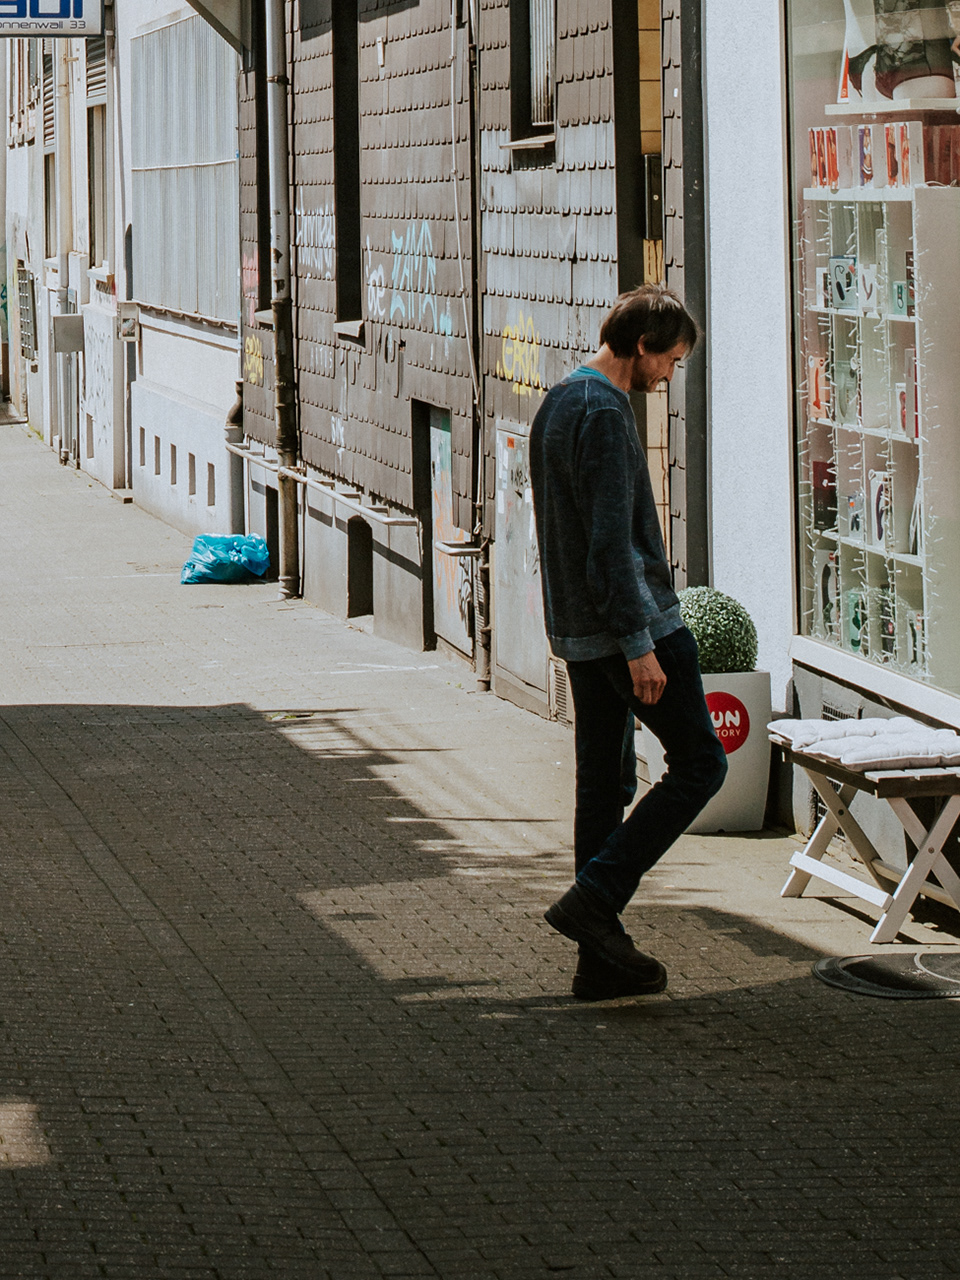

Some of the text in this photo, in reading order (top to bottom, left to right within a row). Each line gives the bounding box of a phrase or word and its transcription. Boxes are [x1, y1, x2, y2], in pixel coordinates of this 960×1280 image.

[69, 20, 87, 30] 33
[710, 710, 741, 728] UN
[715, 729, 741, 737] TORY
